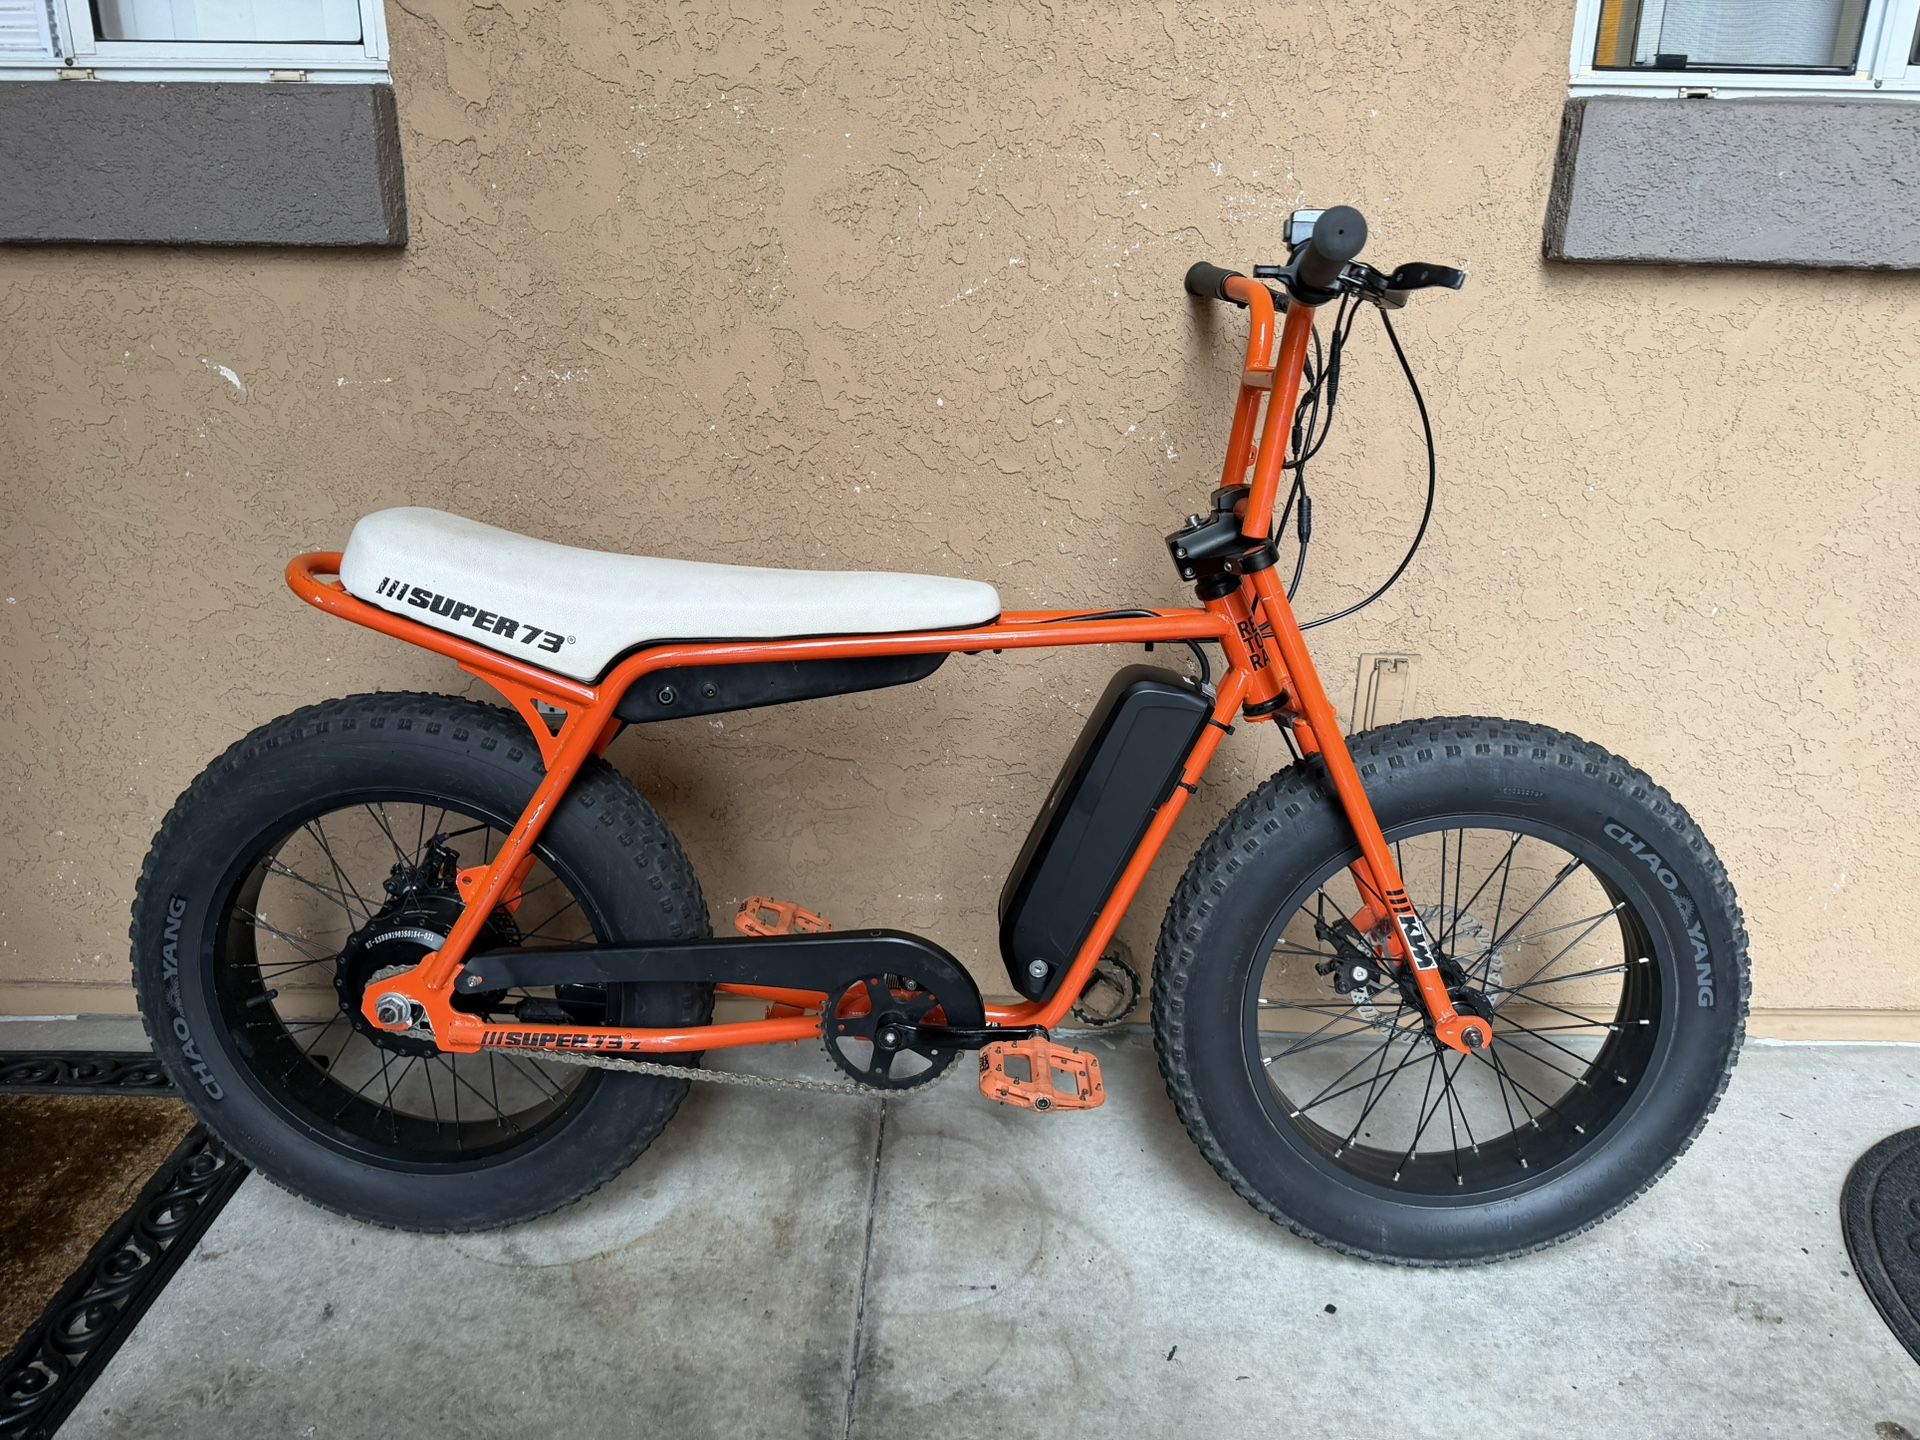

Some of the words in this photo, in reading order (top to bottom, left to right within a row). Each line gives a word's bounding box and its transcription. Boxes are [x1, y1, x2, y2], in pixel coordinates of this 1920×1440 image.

[162, 896, 187, 981] YANG
[1603, 823, 1679, 891] CHAO
[1687, 920, 1714, 1007] YANG
[173, 1016, 224, 1101] CHAO
